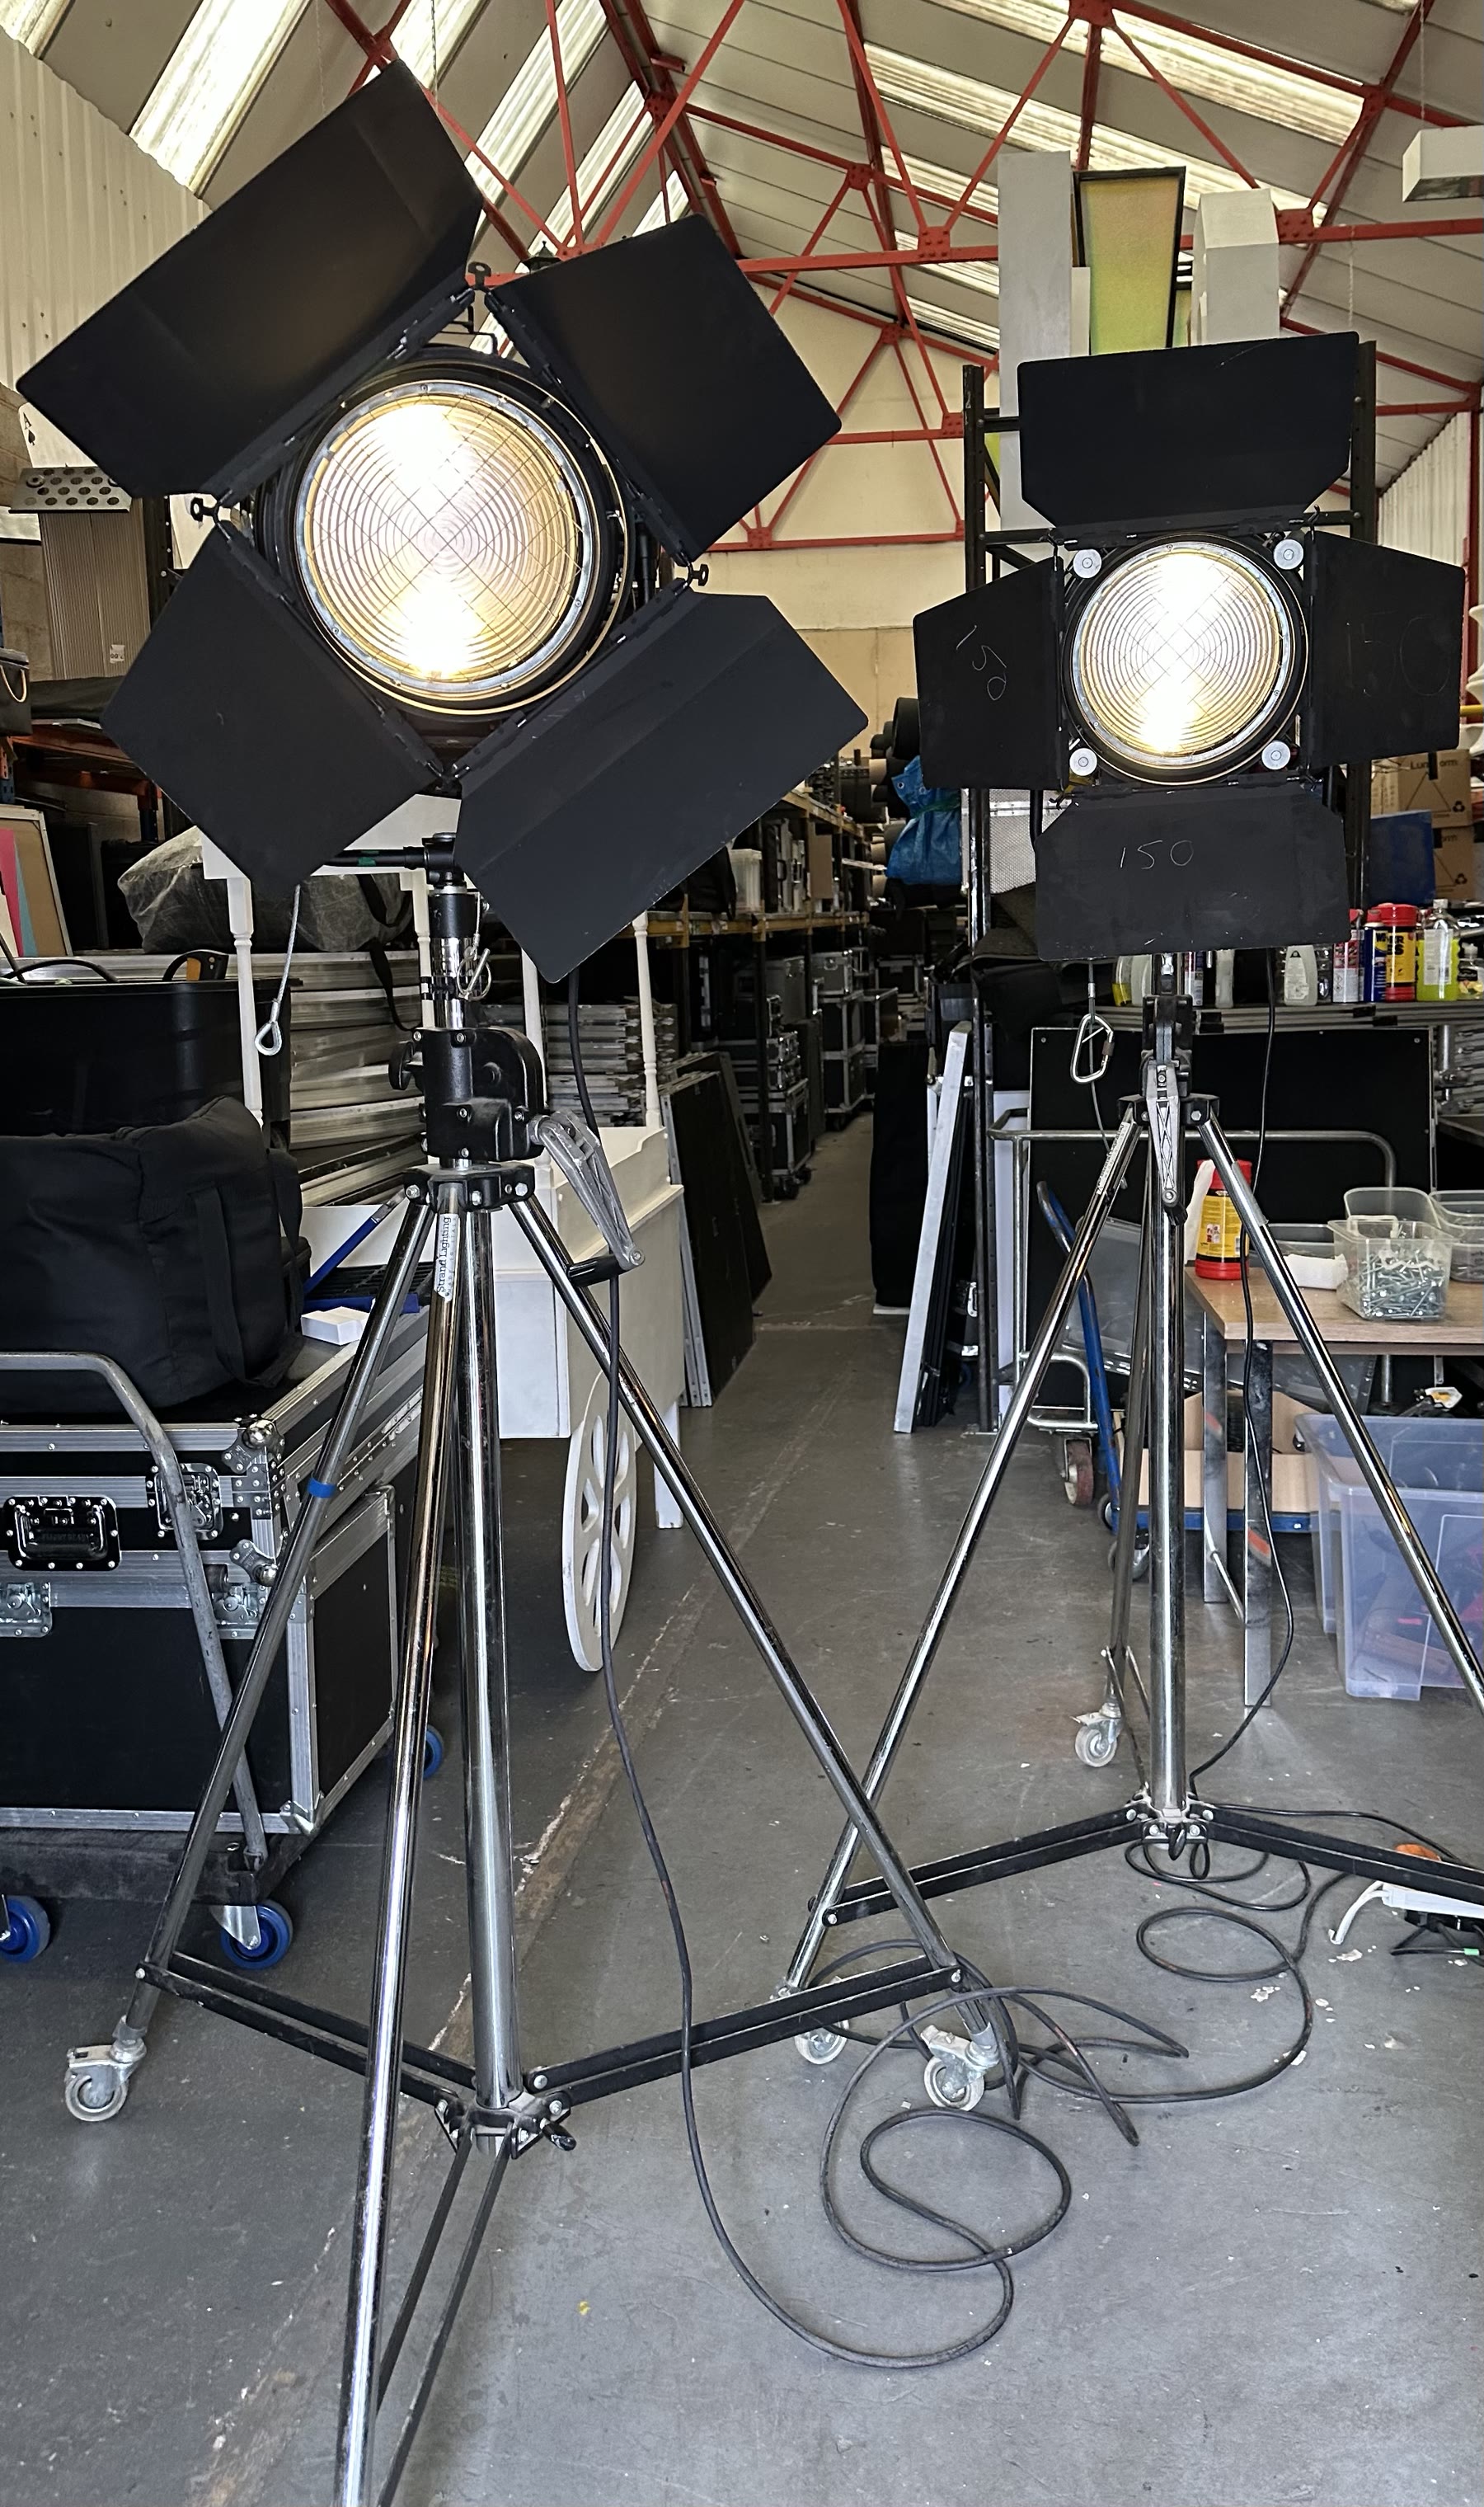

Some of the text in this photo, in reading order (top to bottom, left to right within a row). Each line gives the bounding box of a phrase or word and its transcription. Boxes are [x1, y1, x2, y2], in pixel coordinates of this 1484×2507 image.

[1120, 840, 1194, 869] 150
[436, 1216, 452, 1293] Strand Lighting
